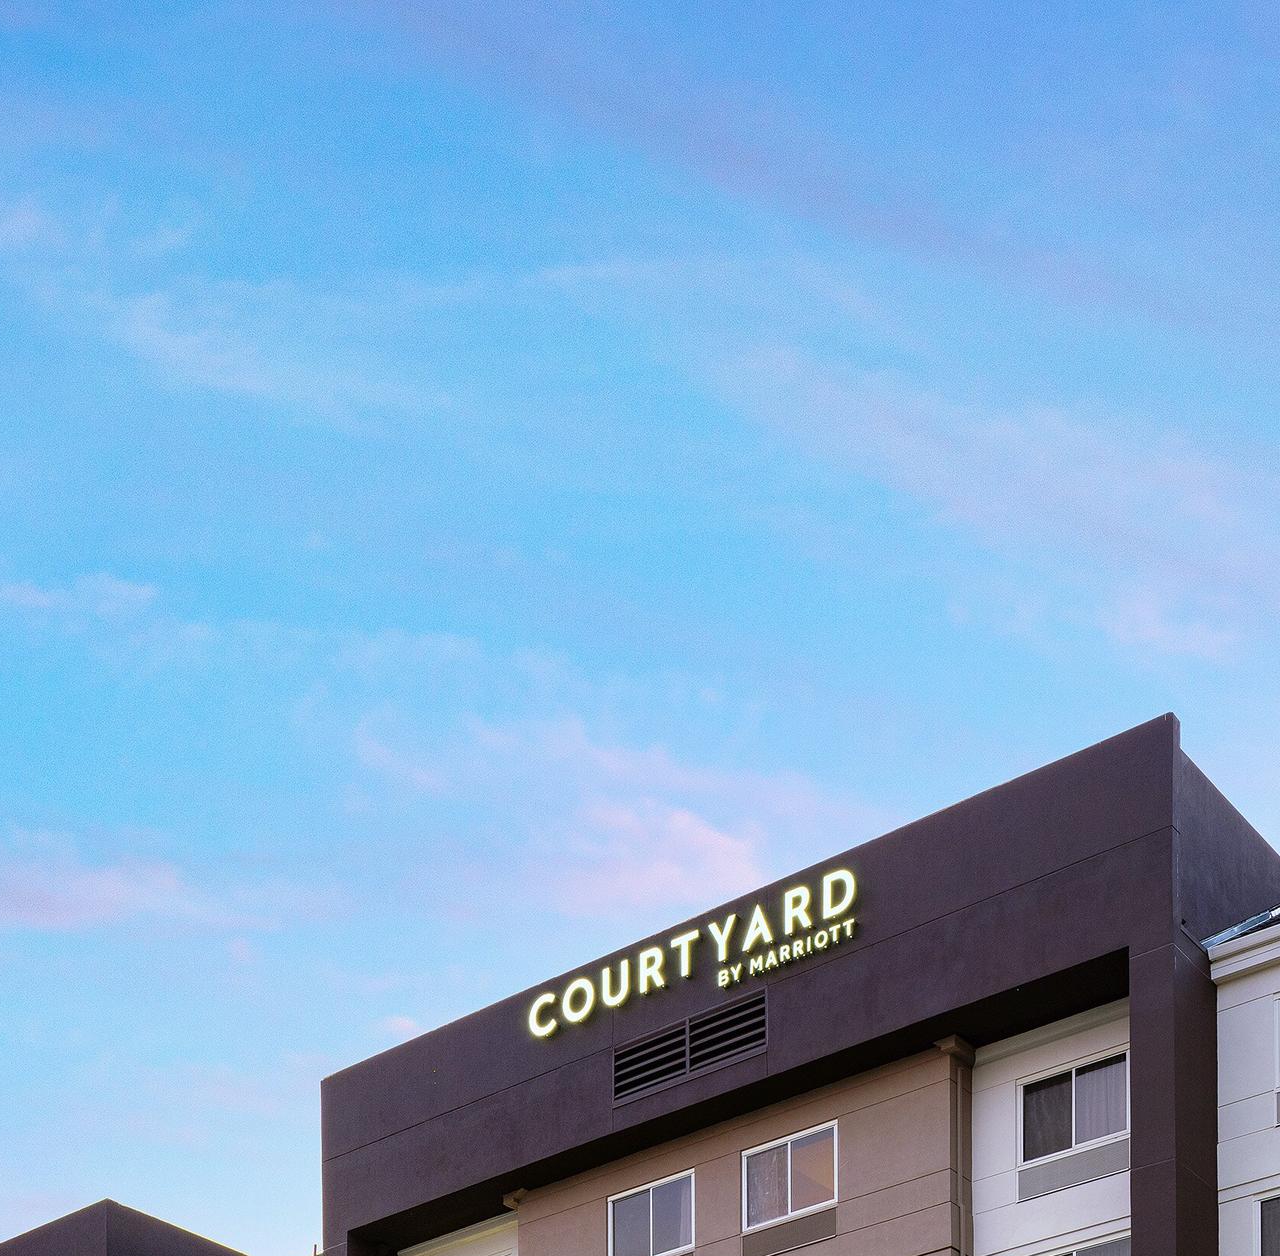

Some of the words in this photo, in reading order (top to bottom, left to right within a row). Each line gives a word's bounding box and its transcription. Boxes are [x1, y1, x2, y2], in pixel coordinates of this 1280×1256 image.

[528, 869, 858, 1037] COURTYARD
[718, 964, 743, 988] BY
[749, 917, 857, 977] MARRIOTT
